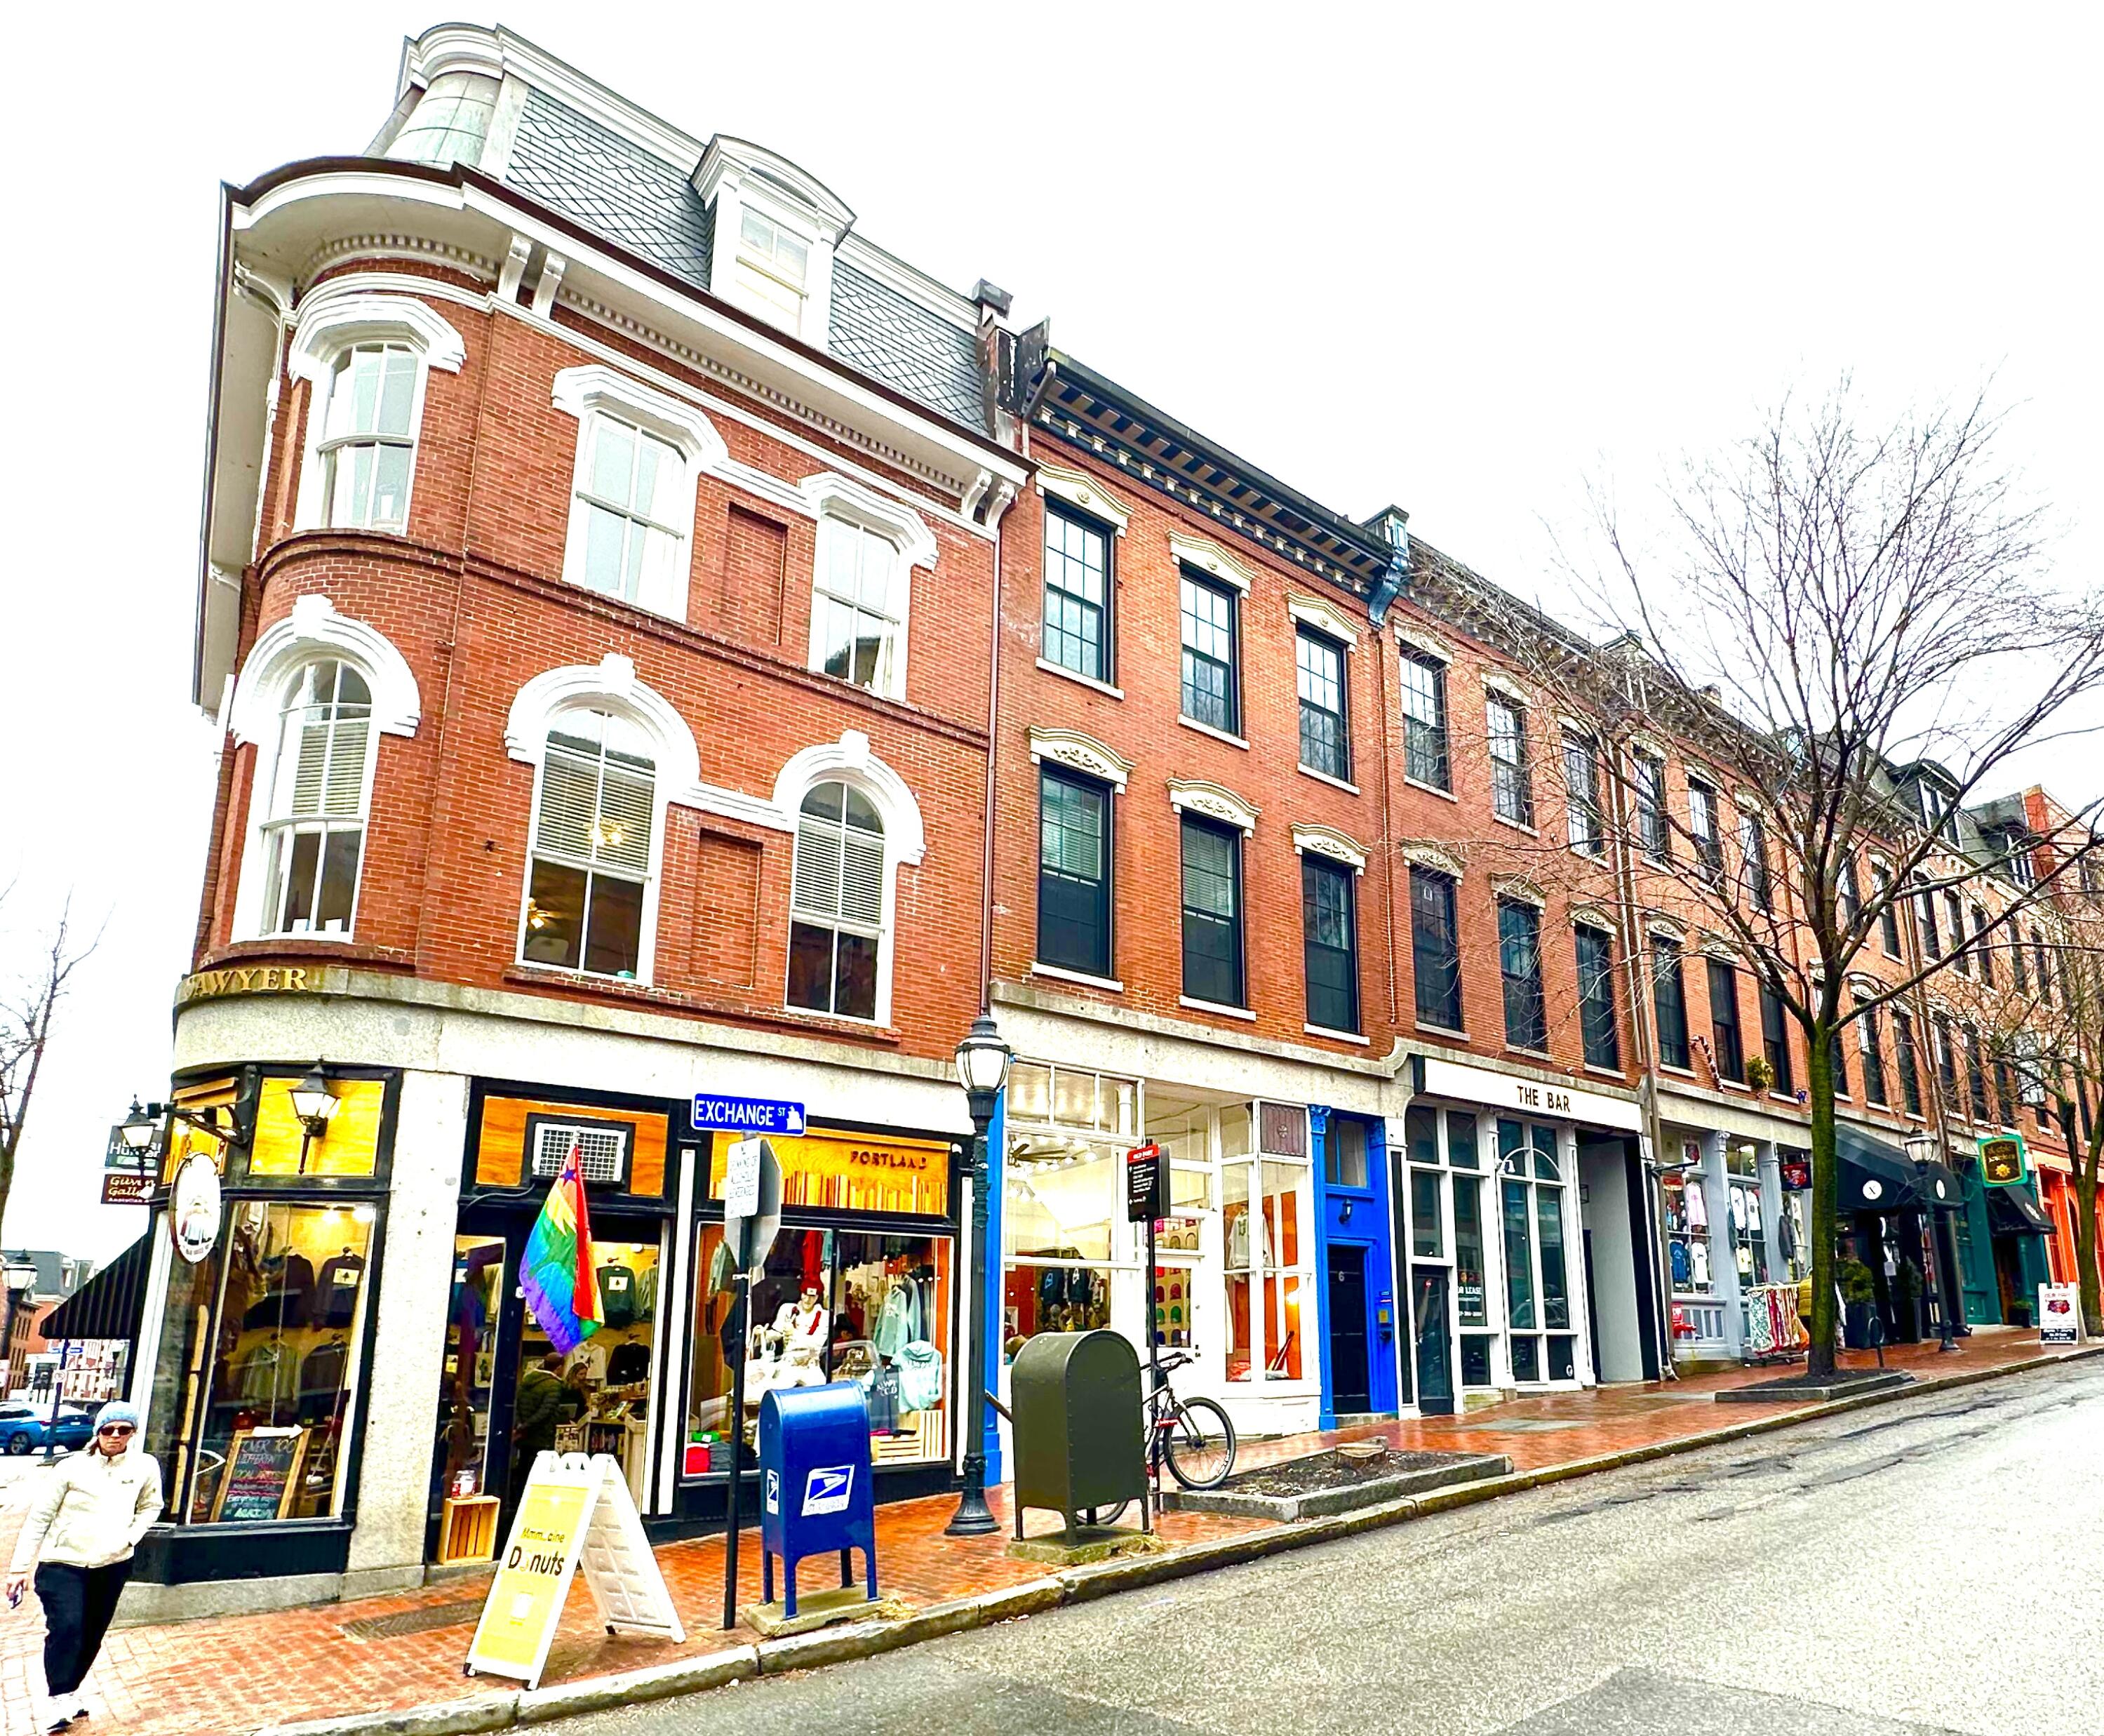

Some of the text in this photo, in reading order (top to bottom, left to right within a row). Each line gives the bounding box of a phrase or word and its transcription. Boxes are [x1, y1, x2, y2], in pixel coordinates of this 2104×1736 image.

[1517, 1086, 1571, 1113] THE BAR
[695, 1100, 786, 1126] EXCHANGE ST
[1338, 1271, 1345, 1282] 6
